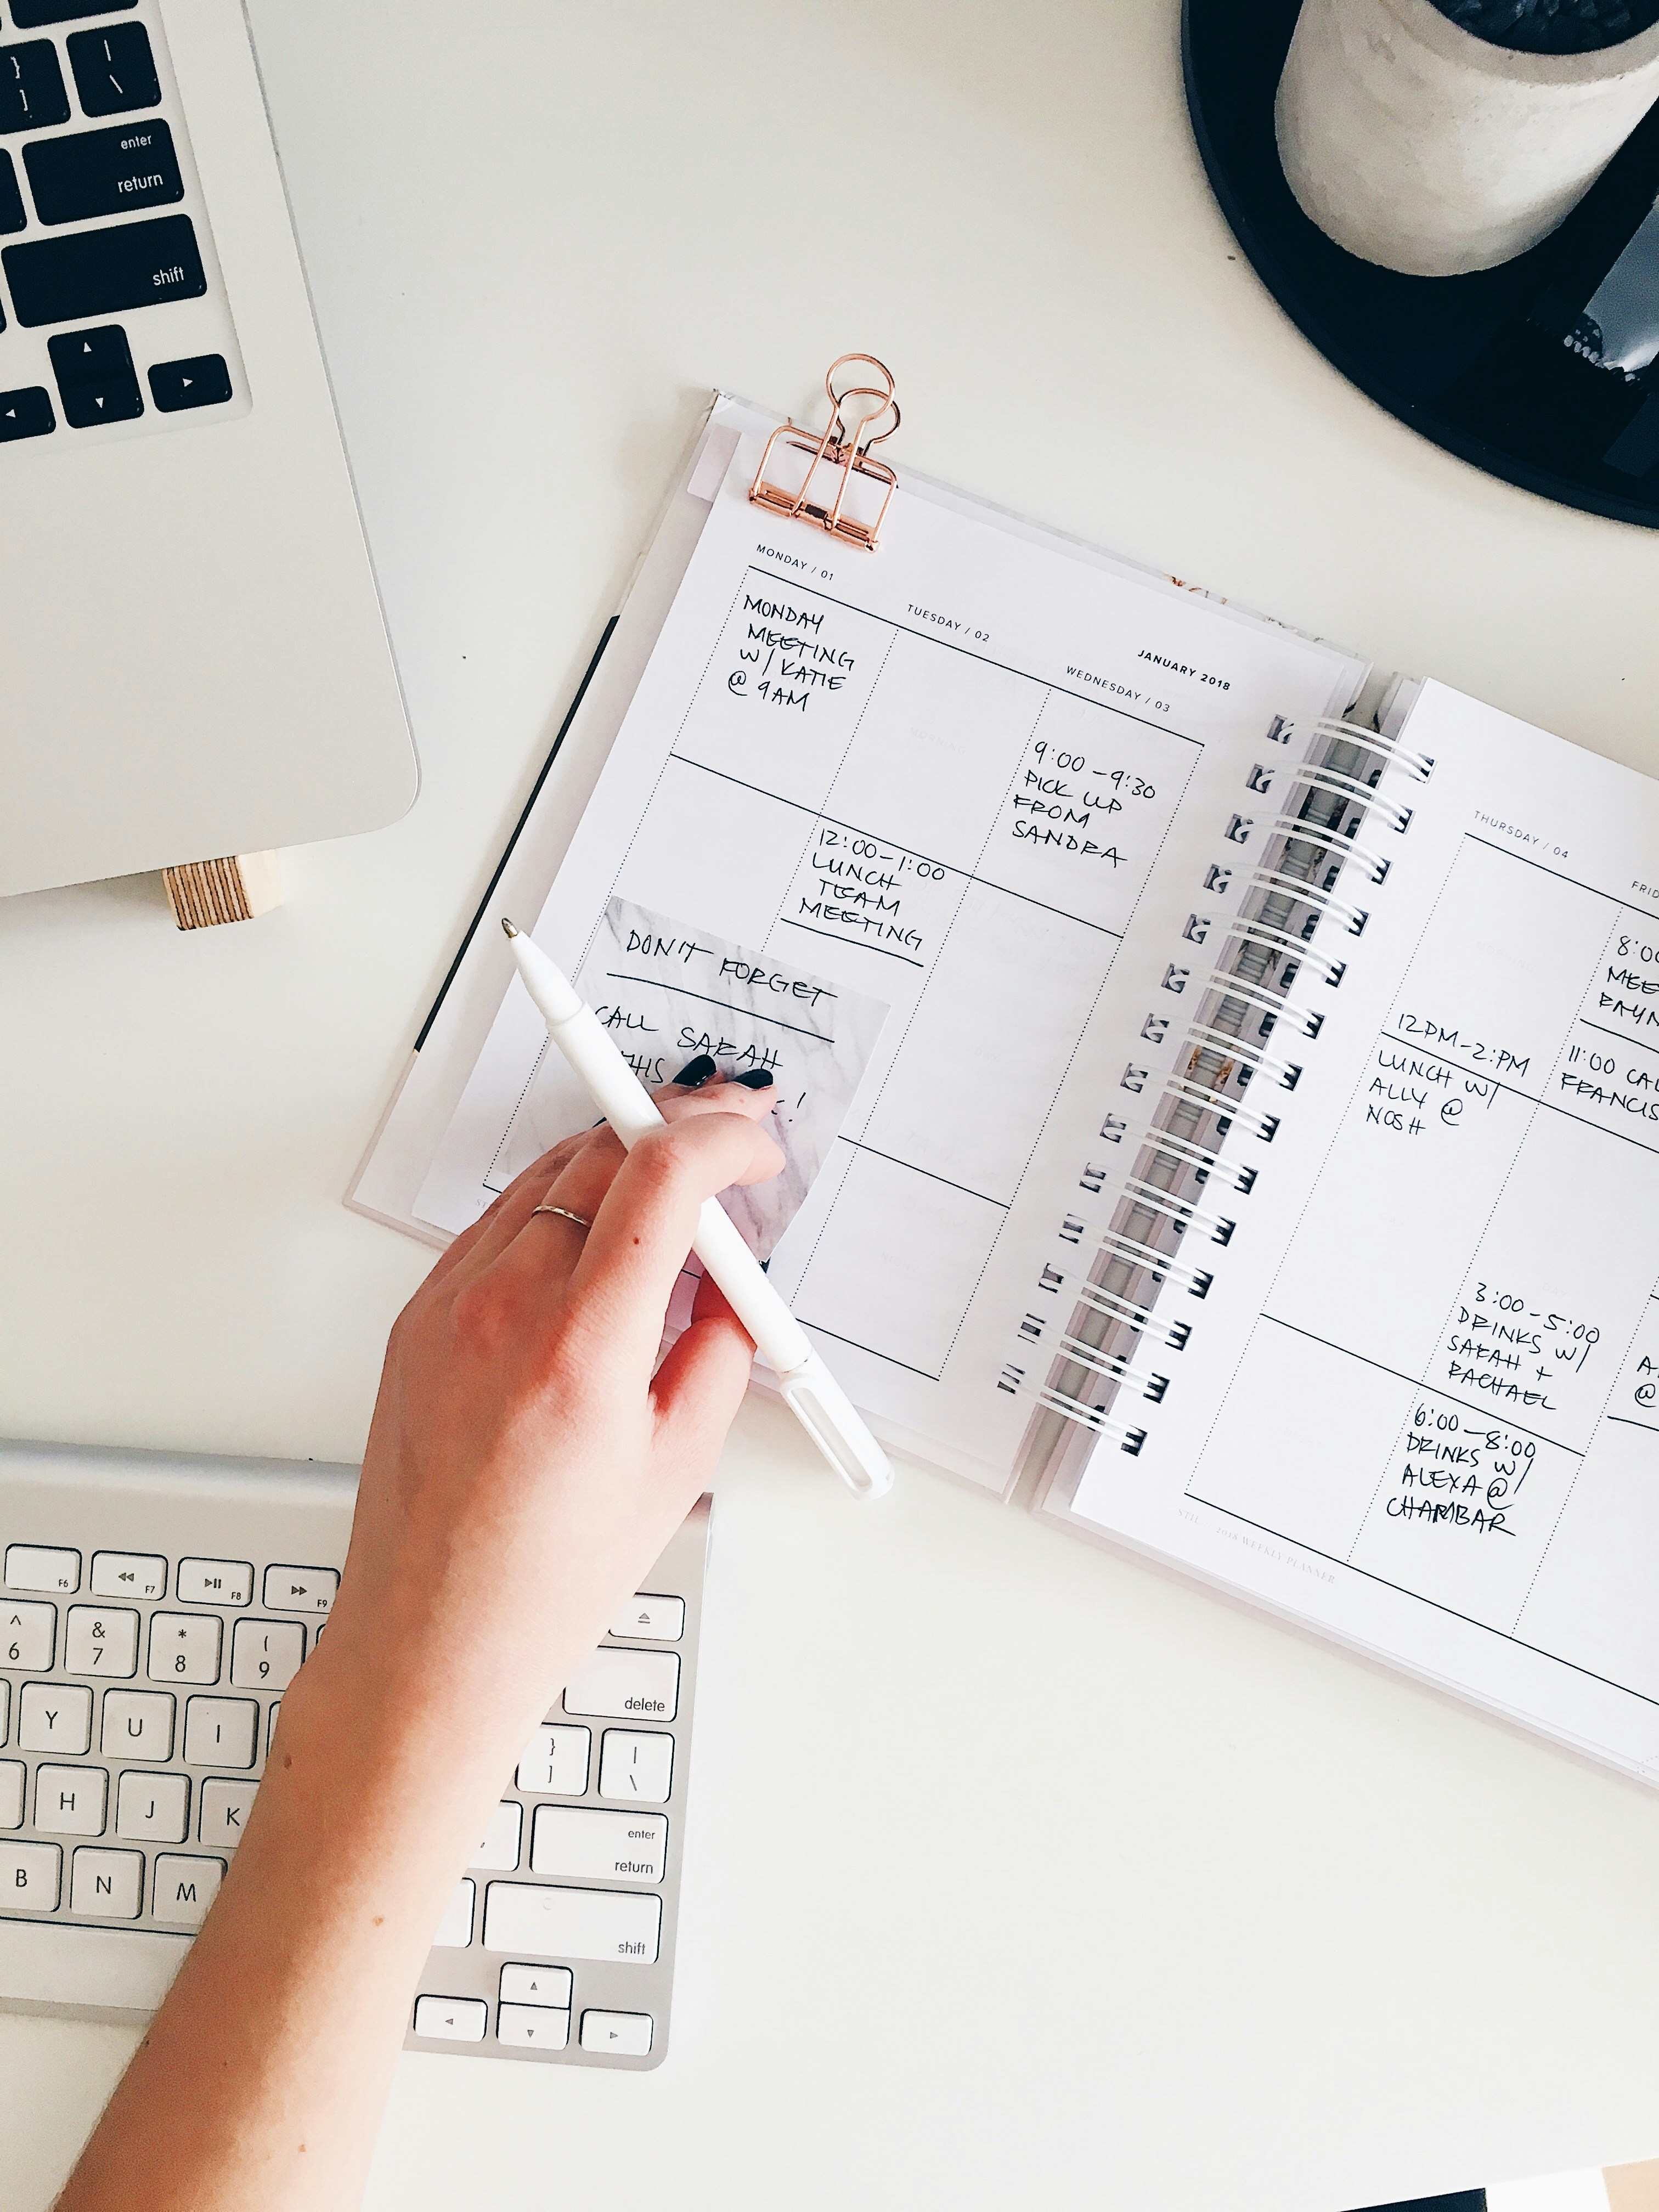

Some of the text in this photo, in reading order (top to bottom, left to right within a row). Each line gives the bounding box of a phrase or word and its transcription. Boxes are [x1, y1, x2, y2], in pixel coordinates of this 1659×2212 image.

[120, 133, 152, 150] enter
[117, 172, 163, 193] return
[153, 267, 184, 286] shift
[757, 544, 808, 569] MONDAY
[821, 569, 834, 581] 01
[743, 594, 825, 635] MONDAY
[908, 603, 990, 642] TUESDAY / 02
[748, 623, 855, 670] MEETING
[782, 658, 847, 690] KATIE
[1138, 649, 1231, 691] JANUARY 2018
[728, 669, 810, 712] @ 9AM
[1066, 665, 1142, 702] WEDNESDAY
[1154, 701, 1171, 713] 03
[1024, 769, 1123, 814] PICK UP
[1013, 794, 1091, 829] FROM
[1012, 820, 1128, 868] SANDRA
[1474, 810, 1570, 859] THURSDAY / 04
[812, 851, 902, 891] LUNCH
[820, 879, 901, 917] TEAM
[798, 897, 924, 951] MEETING
[627, 929, 839, 1007] DON'T FORGET
[677, 1026, 783, 1070] SARAH
[1568, 1045, 1615, 1074] 11:00
[1378, 1048, 1454, 1088] LUNCH
[1369, 1077, 1463, 1126] ALLY @
[1365, 1103, 1426, 1136] NOSH
[1457, 1306, 1542, 1353] DRINKS
[1447, 1335, 1521, 1369] SARAH
[1449, 1360, 1557, 1410] RACHAEL
[1634, 1383, 1657, 1408] @
[1407, 1431, 1481, 1468] DRINKS
[1402, 1463, 1515, 1510] ALEXA @
[1215, 1527, 1239, 1541] 2018
[1242, 1536, 1284, 1561] WEEKLY
[1286, 1556, 1336, 1584] PLANNER
[58, 1578, 69, 1588] F6
[145, 1585, 156, 1595] F7
[231, 1591, 242, 1601] F8
[317, 1598, 328, 1609] F9
[92, 1621, 106, 1638] &
[8, 1643, 20, 1661] 6
[93, 1647, 104, 1666] 7
[174, 1655, 187, 1672] 8
[258, 1661, 270, 1679] 9
[624, 1697, 665, 1712] delete
[45, 1710, 58, 1729] Y
[128, 1717, 143, 1737] U
[216, 1724, 221, 1743] I
[60, 1792, 76, 1812] H
[145, 1801, 155, 1819] J
[227, 1807, 241, 1826] K
[628, 1828, 656, 1840] enter
[15, 1869, 28, 1887] B
[614, 1860, 654, 1875] return
[97, 1875, 112, 1894] N
[176, 1882, 196, 1903] M
[618, 1942, 646, 1955] shift
